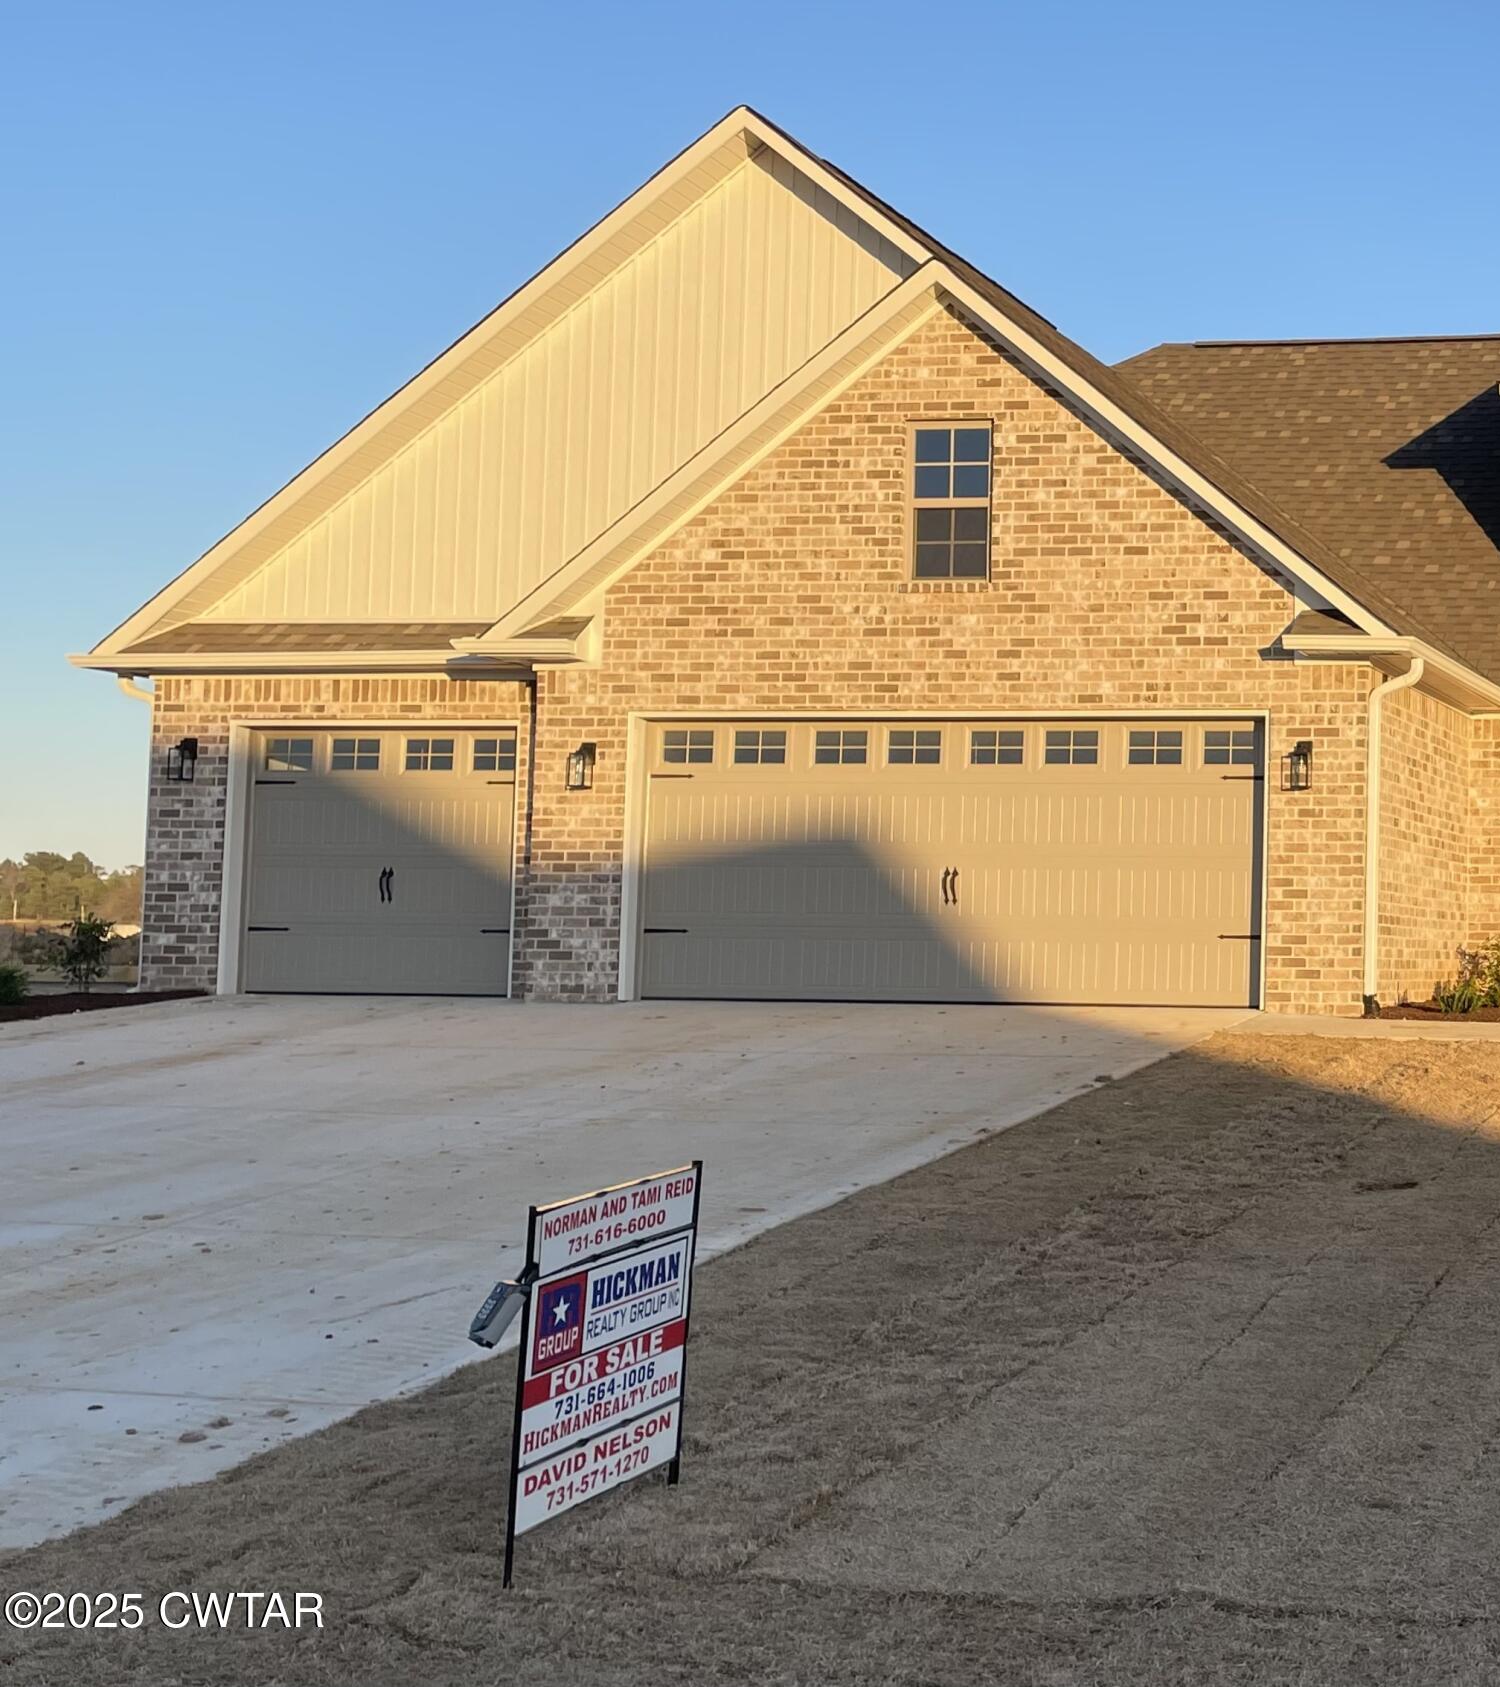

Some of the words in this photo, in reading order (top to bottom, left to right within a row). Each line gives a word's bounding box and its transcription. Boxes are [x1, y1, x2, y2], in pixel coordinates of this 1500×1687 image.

[544, 1204, 597, 1240] NORMAN
[600, 1195, 628, 1220] AND
[631, 1186, 661, 1210] TAMI
[665, 1177, 694, 1198] REID
[567, 1209, 666, 1255] 731-616-6000
[592, 1251, 681, 1309] HICKMAN
[538, 1326, 579, 1360] GROUP
[586, 1310, 627, 1341] REALTY
[630, 1293, 667, 1323] GROUP
[550, 1357, 599, 1399] FOR
[605, 1328, 664, 1374] SALE
[555, 1361, 655, 1419] 731-664-1006
[524, 1455, 587, 1497] DAVID
[594, 1412, 672, 1461] NELSON
[547, 1446, 650, 1510] 731-571-1270
